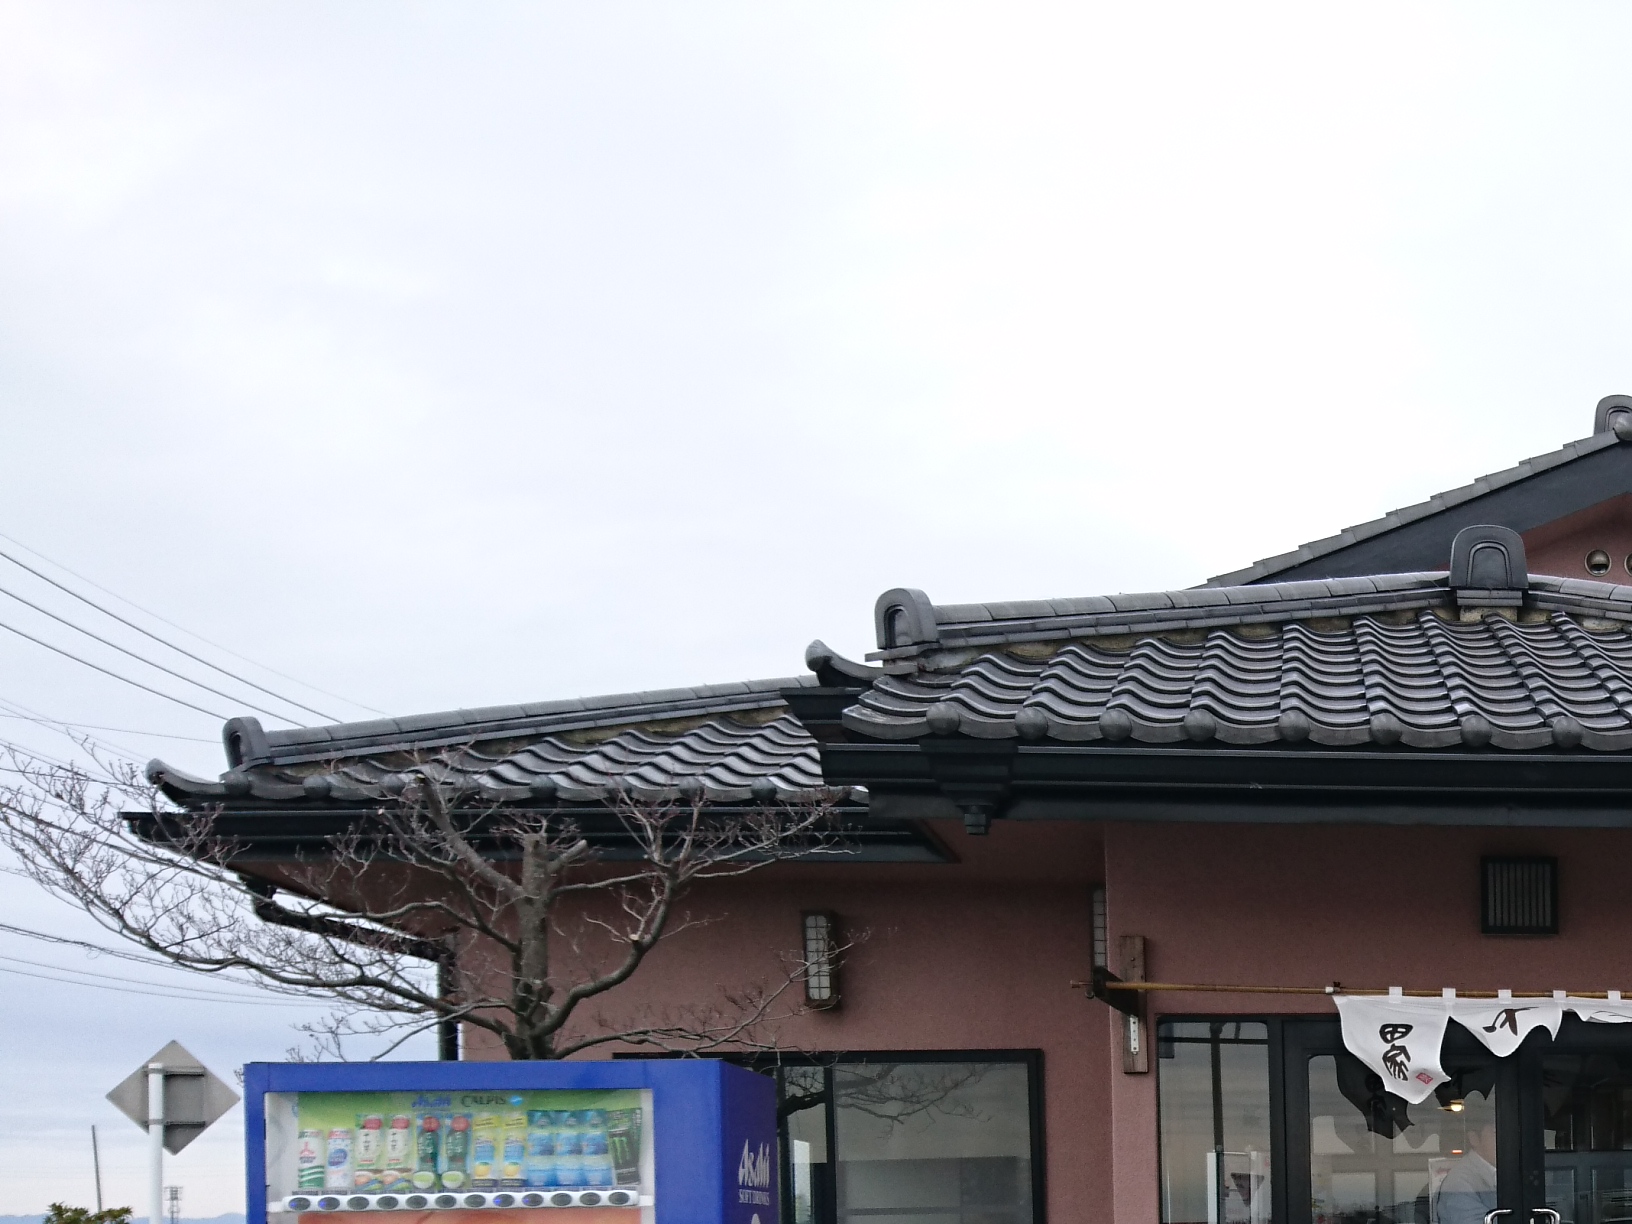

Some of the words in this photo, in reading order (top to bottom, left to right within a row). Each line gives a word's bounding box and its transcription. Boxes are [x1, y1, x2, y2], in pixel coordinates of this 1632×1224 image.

[738, 1139, 770, 1188] Asahi
[739, 1189, 750, 1204] SOFT
[752, 1190, 770, 1206] DRINKS
